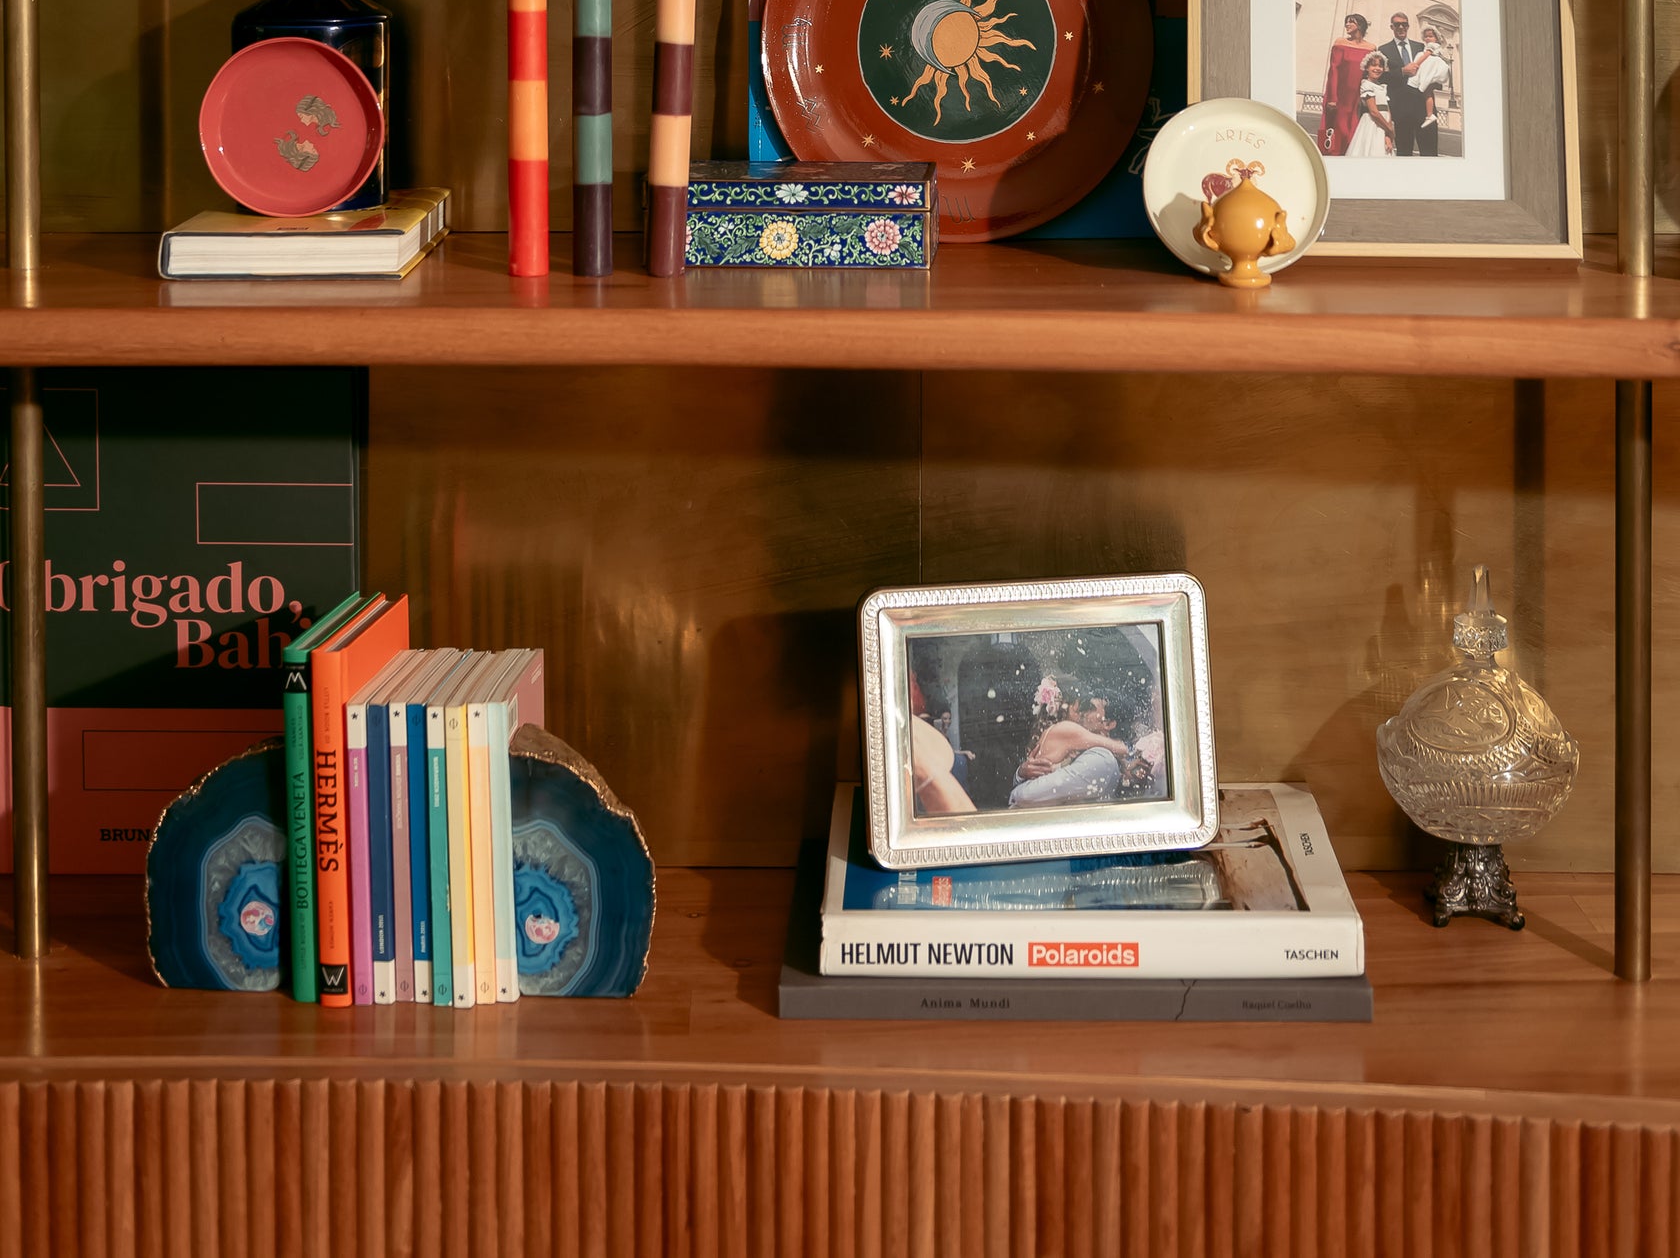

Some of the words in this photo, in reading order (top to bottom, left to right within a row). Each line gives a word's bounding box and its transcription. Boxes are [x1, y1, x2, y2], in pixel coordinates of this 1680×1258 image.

[1215, 128, 1266, 150] ARIES
[0, 560, 303, 629] brigado,
[173, 617, 312, 669] Bah
[292, 771, 306, 832] VENETA
[316, 750, 343, 872] HERMÈS
[294, 836, 309, 910] BOTTEGA
[841, 943, 921, 965] HELMUT
[928, 943, 1014, 965] NEWTON
[1032, 943, 1136, 965] Polaroids
[1284, 949, 1339, 960] TASCHEN
[322, 966, 345, 986] W
[920, 997, 962, 1009] Anima
[969, 997, 1010, 1009] Mundi
